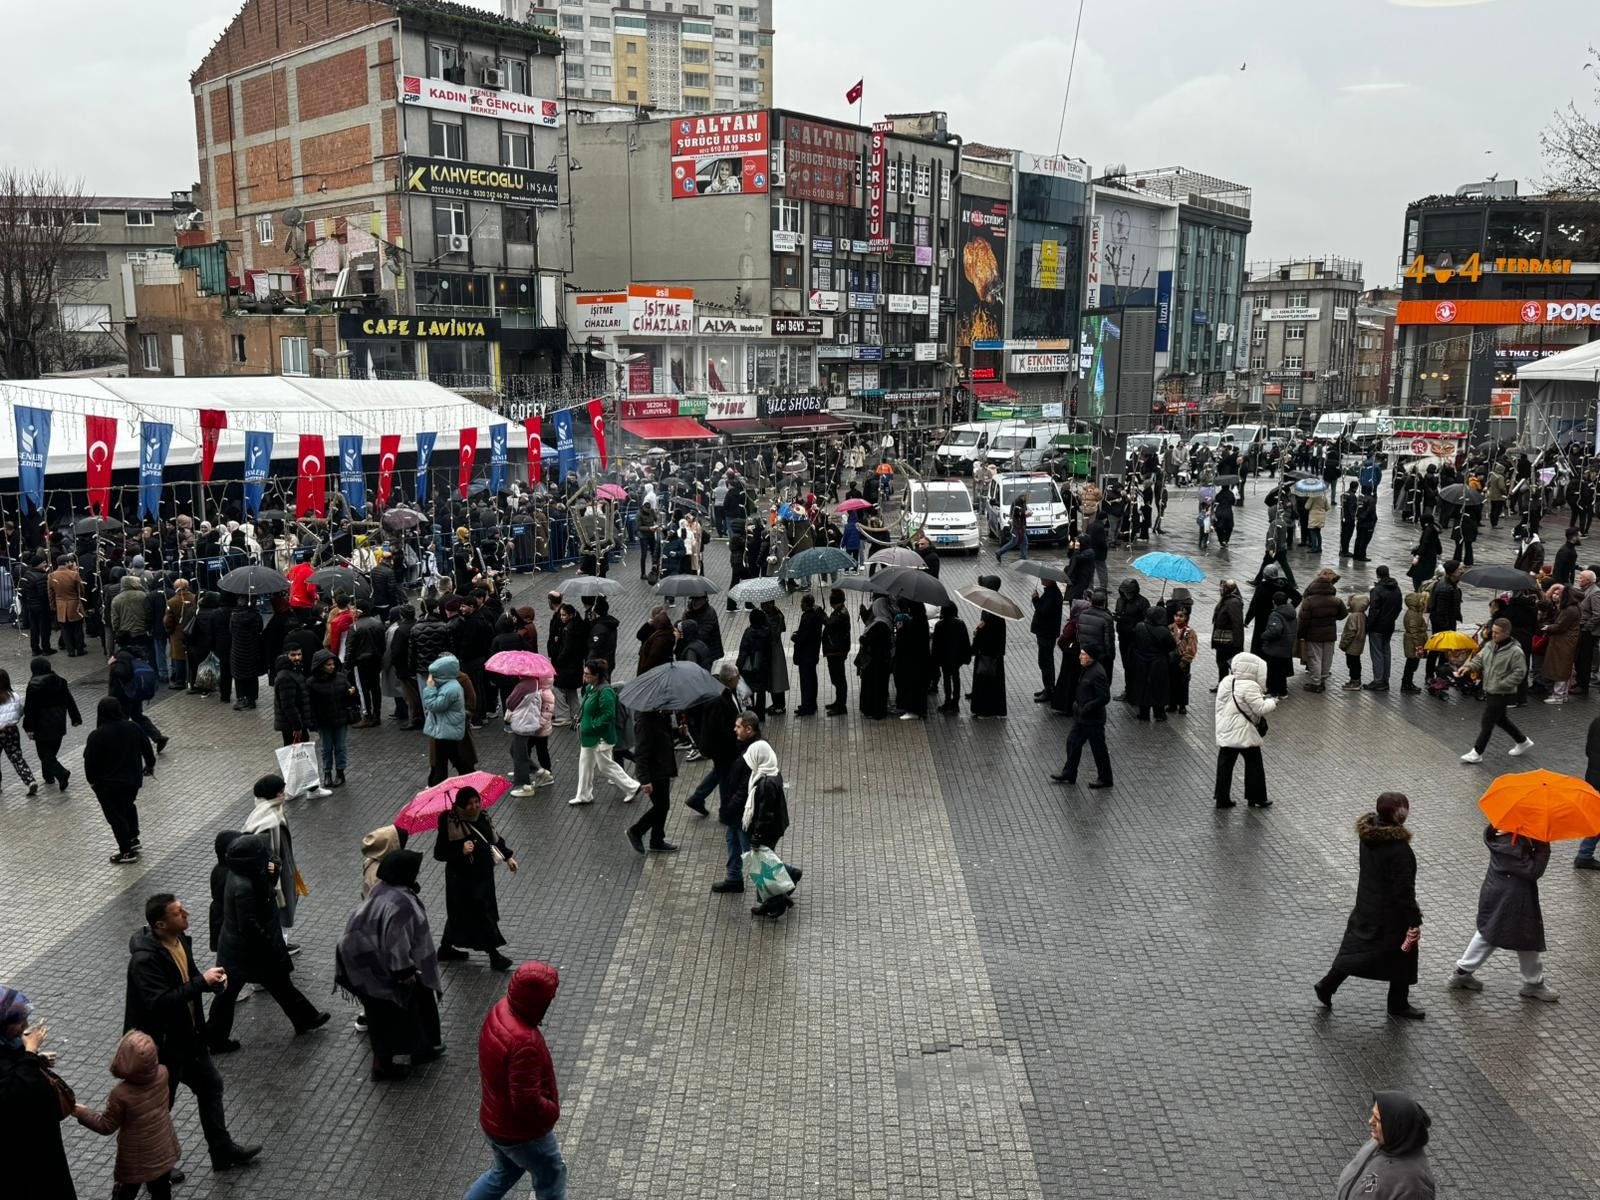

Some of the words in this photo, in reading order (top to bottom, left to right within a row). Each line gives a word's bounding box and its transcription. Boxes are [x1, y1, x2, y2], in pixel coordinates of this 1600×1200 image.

[404, 94, 420, 102] CHP
[470, 89, 497, 98] ESENLER
[430, 88, 467, 103] KADIN
[486, 98, 534, 114] GENÇLİK
[470, 106, 498, 115] MERKEZİ
[696, 114, 758, 134] ALTAN
[872, 122, 893, 132] ALTAN
[802, 126, 855, 152] ALTAN
[827, 155, 854, 171] KURSU
[431, 185, 444, 194] 0212
[526, 182, 558, 194] İNŞAAT
[870, 136, 881, 234] SÜRÜCÜ
[812, 188, 824, 198] 610
[836, 192, 844, 200] 99
[591, 305, 613, 316] İŞİTME
[362, 319, 410, 336] CAFE
[417, 319, 485, 337] LAVİNYA
[585, 318, 621, 328] CİHAZLARI
[633, 315, 691, 331] CİHAZLARI
[703, 320, 737, 332] ALYA
[789, 397, 821, 410] SHOES
